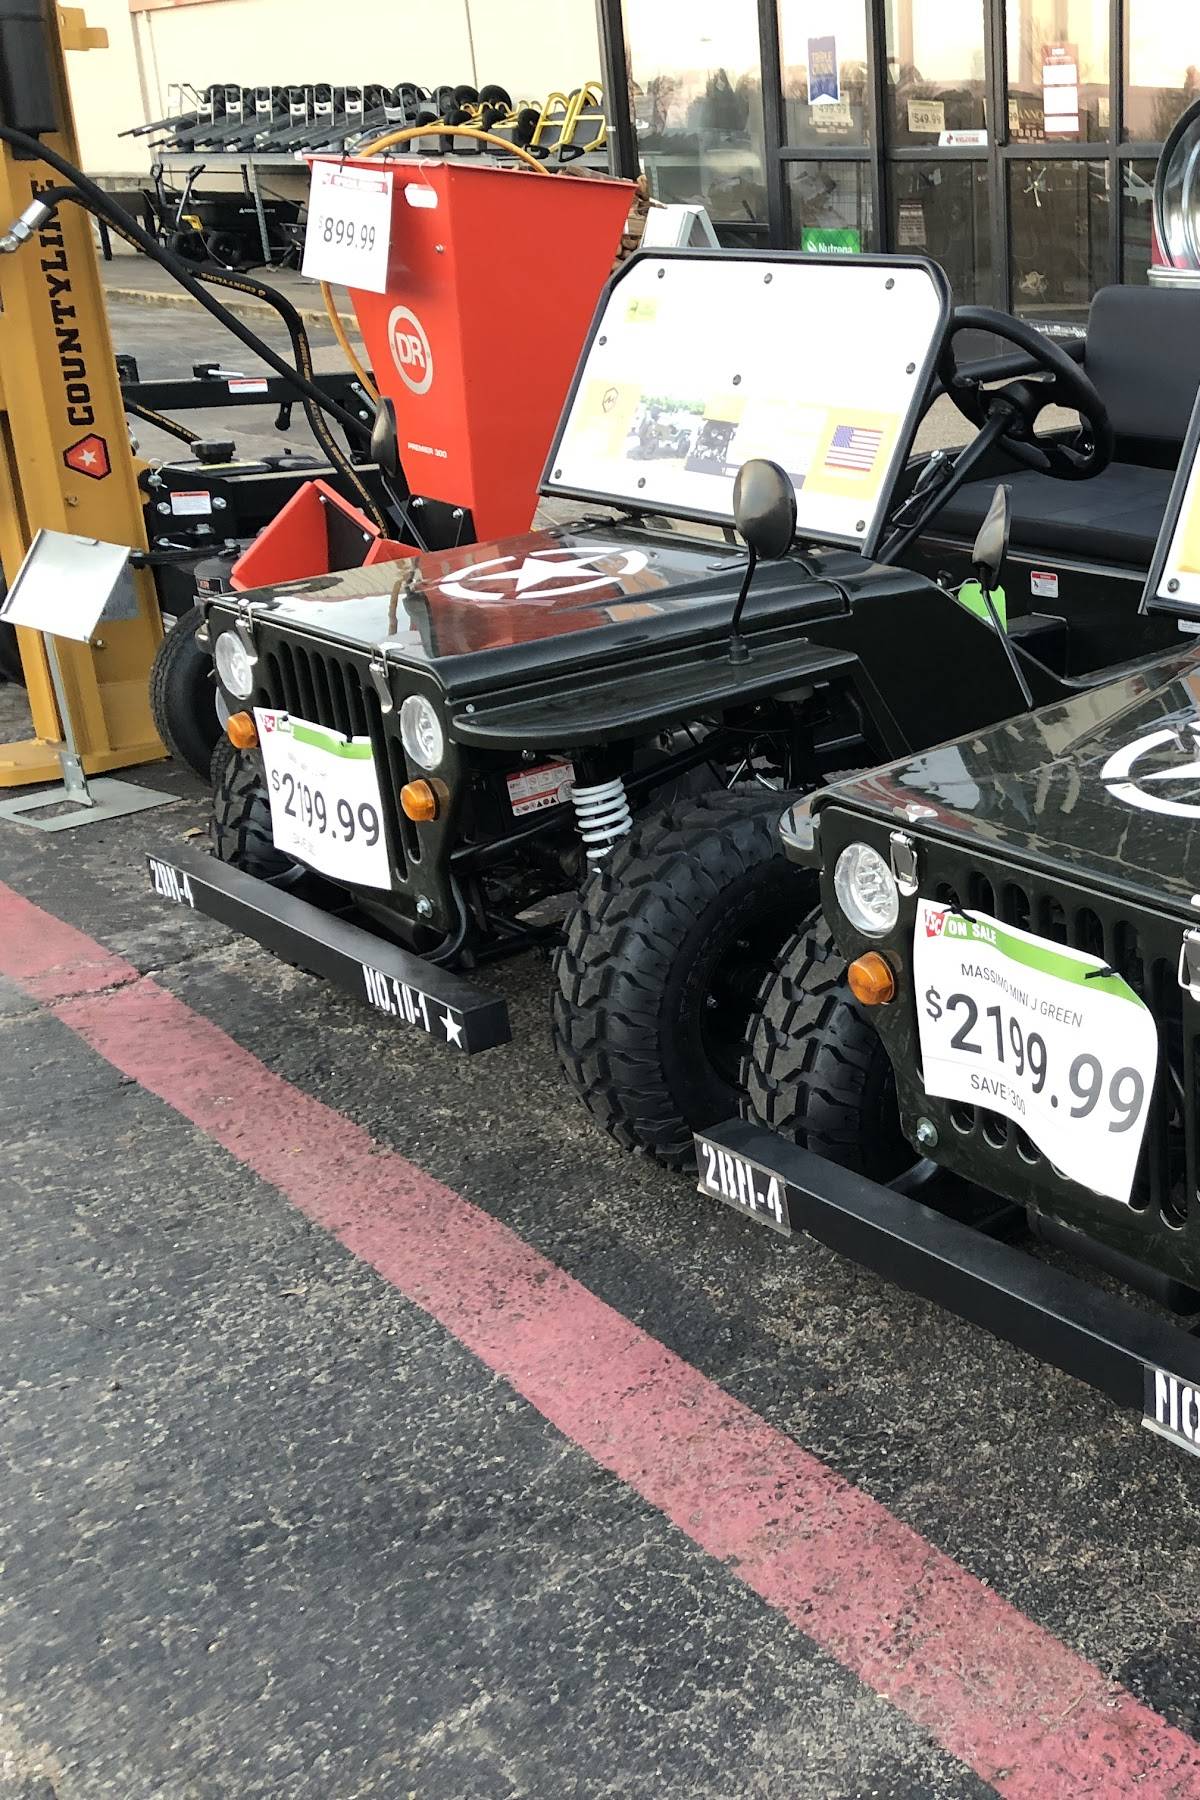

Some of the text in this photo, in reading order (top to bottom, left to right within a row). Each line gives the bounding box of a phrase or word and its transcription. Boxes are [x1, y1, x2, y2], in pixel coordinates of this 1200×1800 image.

[319, 215, 376, 251] $899.99
[818, 242, 853, 253] Nutrena
[31, 179, 95, 427] COUNTYLINE
[395, 331, 425, 369] DR
[407, 442, 434, 455] PREMIER
[271, 768, 380, 848] $2199.99
[948, 920, 997, 945] ON SALE
[961, 963, 1083, 1028] MASSIMO MINI J GREEN
[925, 985, 1146, 1134] $2199.99
[970, 1073, 1007, 1100] SAVE
